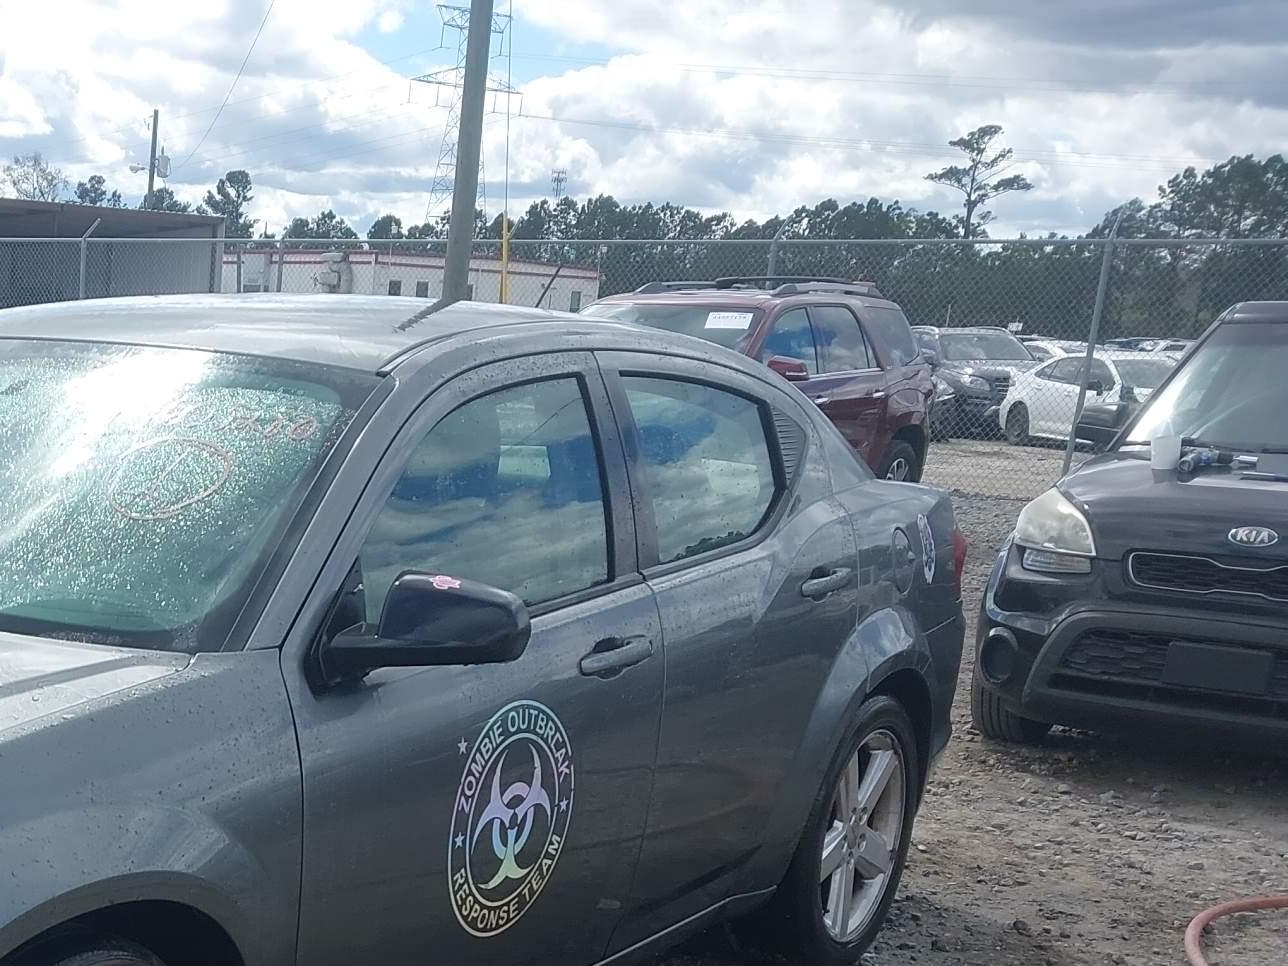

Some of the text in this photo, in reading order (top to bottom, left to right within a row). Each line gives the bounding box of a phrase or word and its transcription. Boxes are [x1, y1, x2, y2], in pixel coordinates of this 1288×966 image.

[1236, 530, 1268, 543] KIA
[459, 708, 570, 814] ZOMBIE OUTBREAK
[453, 834, 561, 929] RESPONSE TEAM
